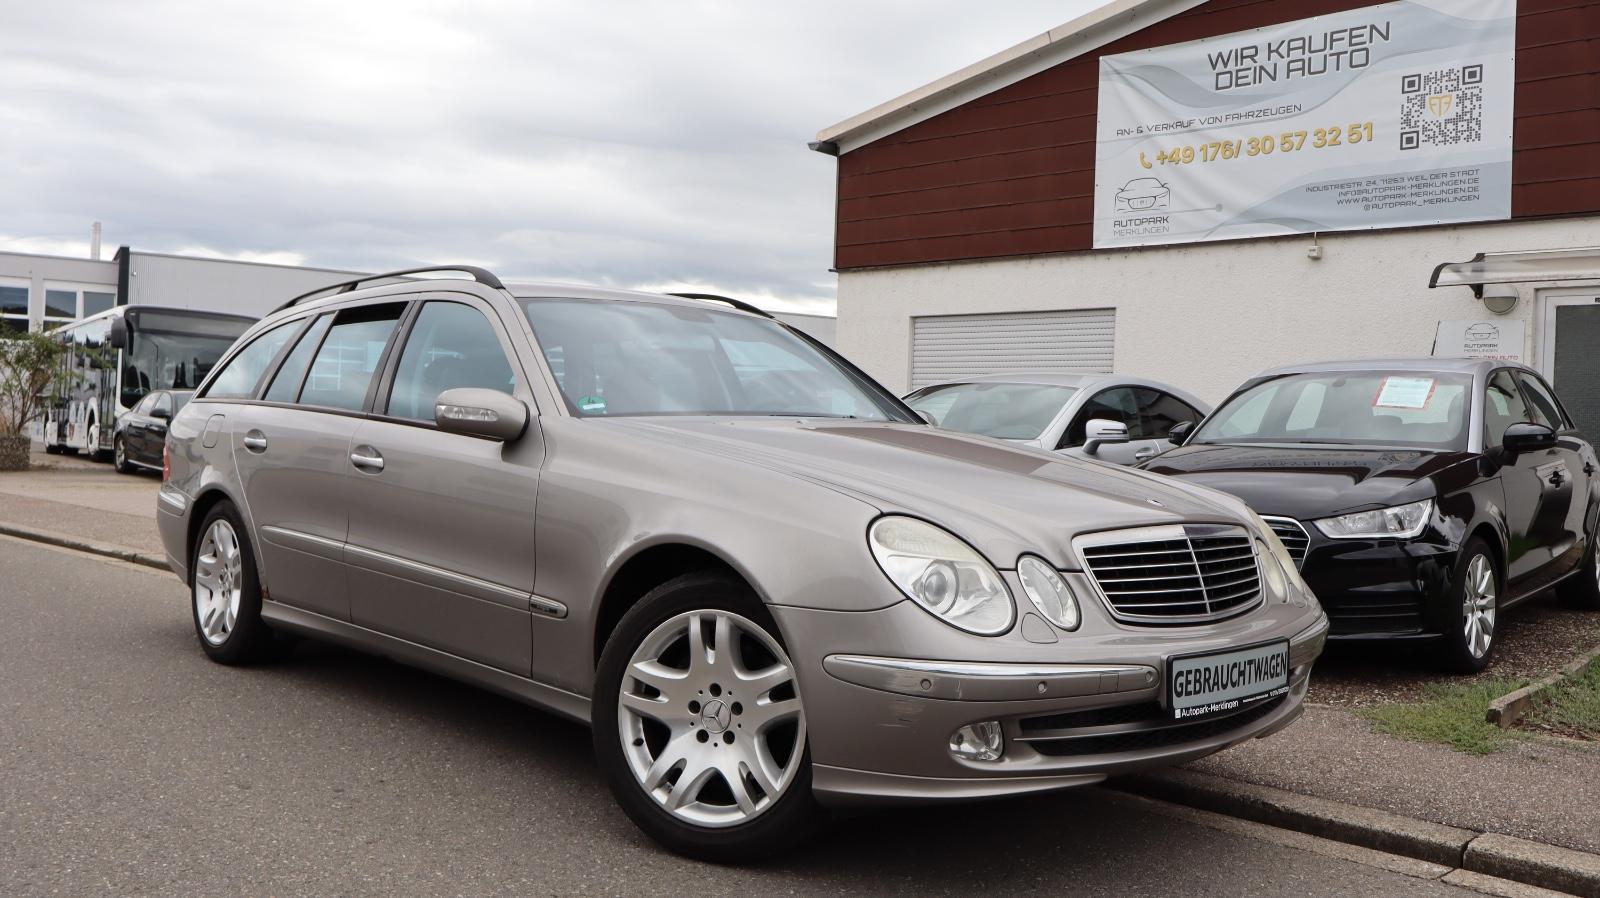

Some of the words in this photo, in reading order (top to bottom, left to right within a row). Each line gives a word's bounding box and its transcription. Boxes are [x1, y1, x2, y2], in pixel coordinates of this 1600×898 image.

[1207, 45, 1259, 71] WIR
[1267, 21, 1391, 61] KAUFEN
[1215, 63, 1278, 91] DEIN
[1286, 47, 1370, 79] AUTO
[1116, 128, 1135, 137] AN-
[1136, 126, 1144, 134] &
[1146, 119, 1196, 132] VERKAUF
[1198, 115, 1223, 126] VON
[1225, 104, 1303, 122] FAHRZEUGEN
[1156, 145, 1195, 165] +49
[1199, 139, 1243, 162] 176/
[1247, 135, 1275, 157] 30
[1280, 130, 1308, 153] 57
[1312, 127, 1342, 149] 32
[1347, 121, 1374, 144] 51
[1407, 174, 1428, 182] WEIL
[1429, 172, 1448, 180] DER
[1449, 168, 1480, 178] STADT
[1113, 215, 1170, 228] AUTOPARK
[1113, 226, 1170, 237] MERKLINGEN
[1173, 651, 1288, 698] GEBRAUCHTWAGEN
